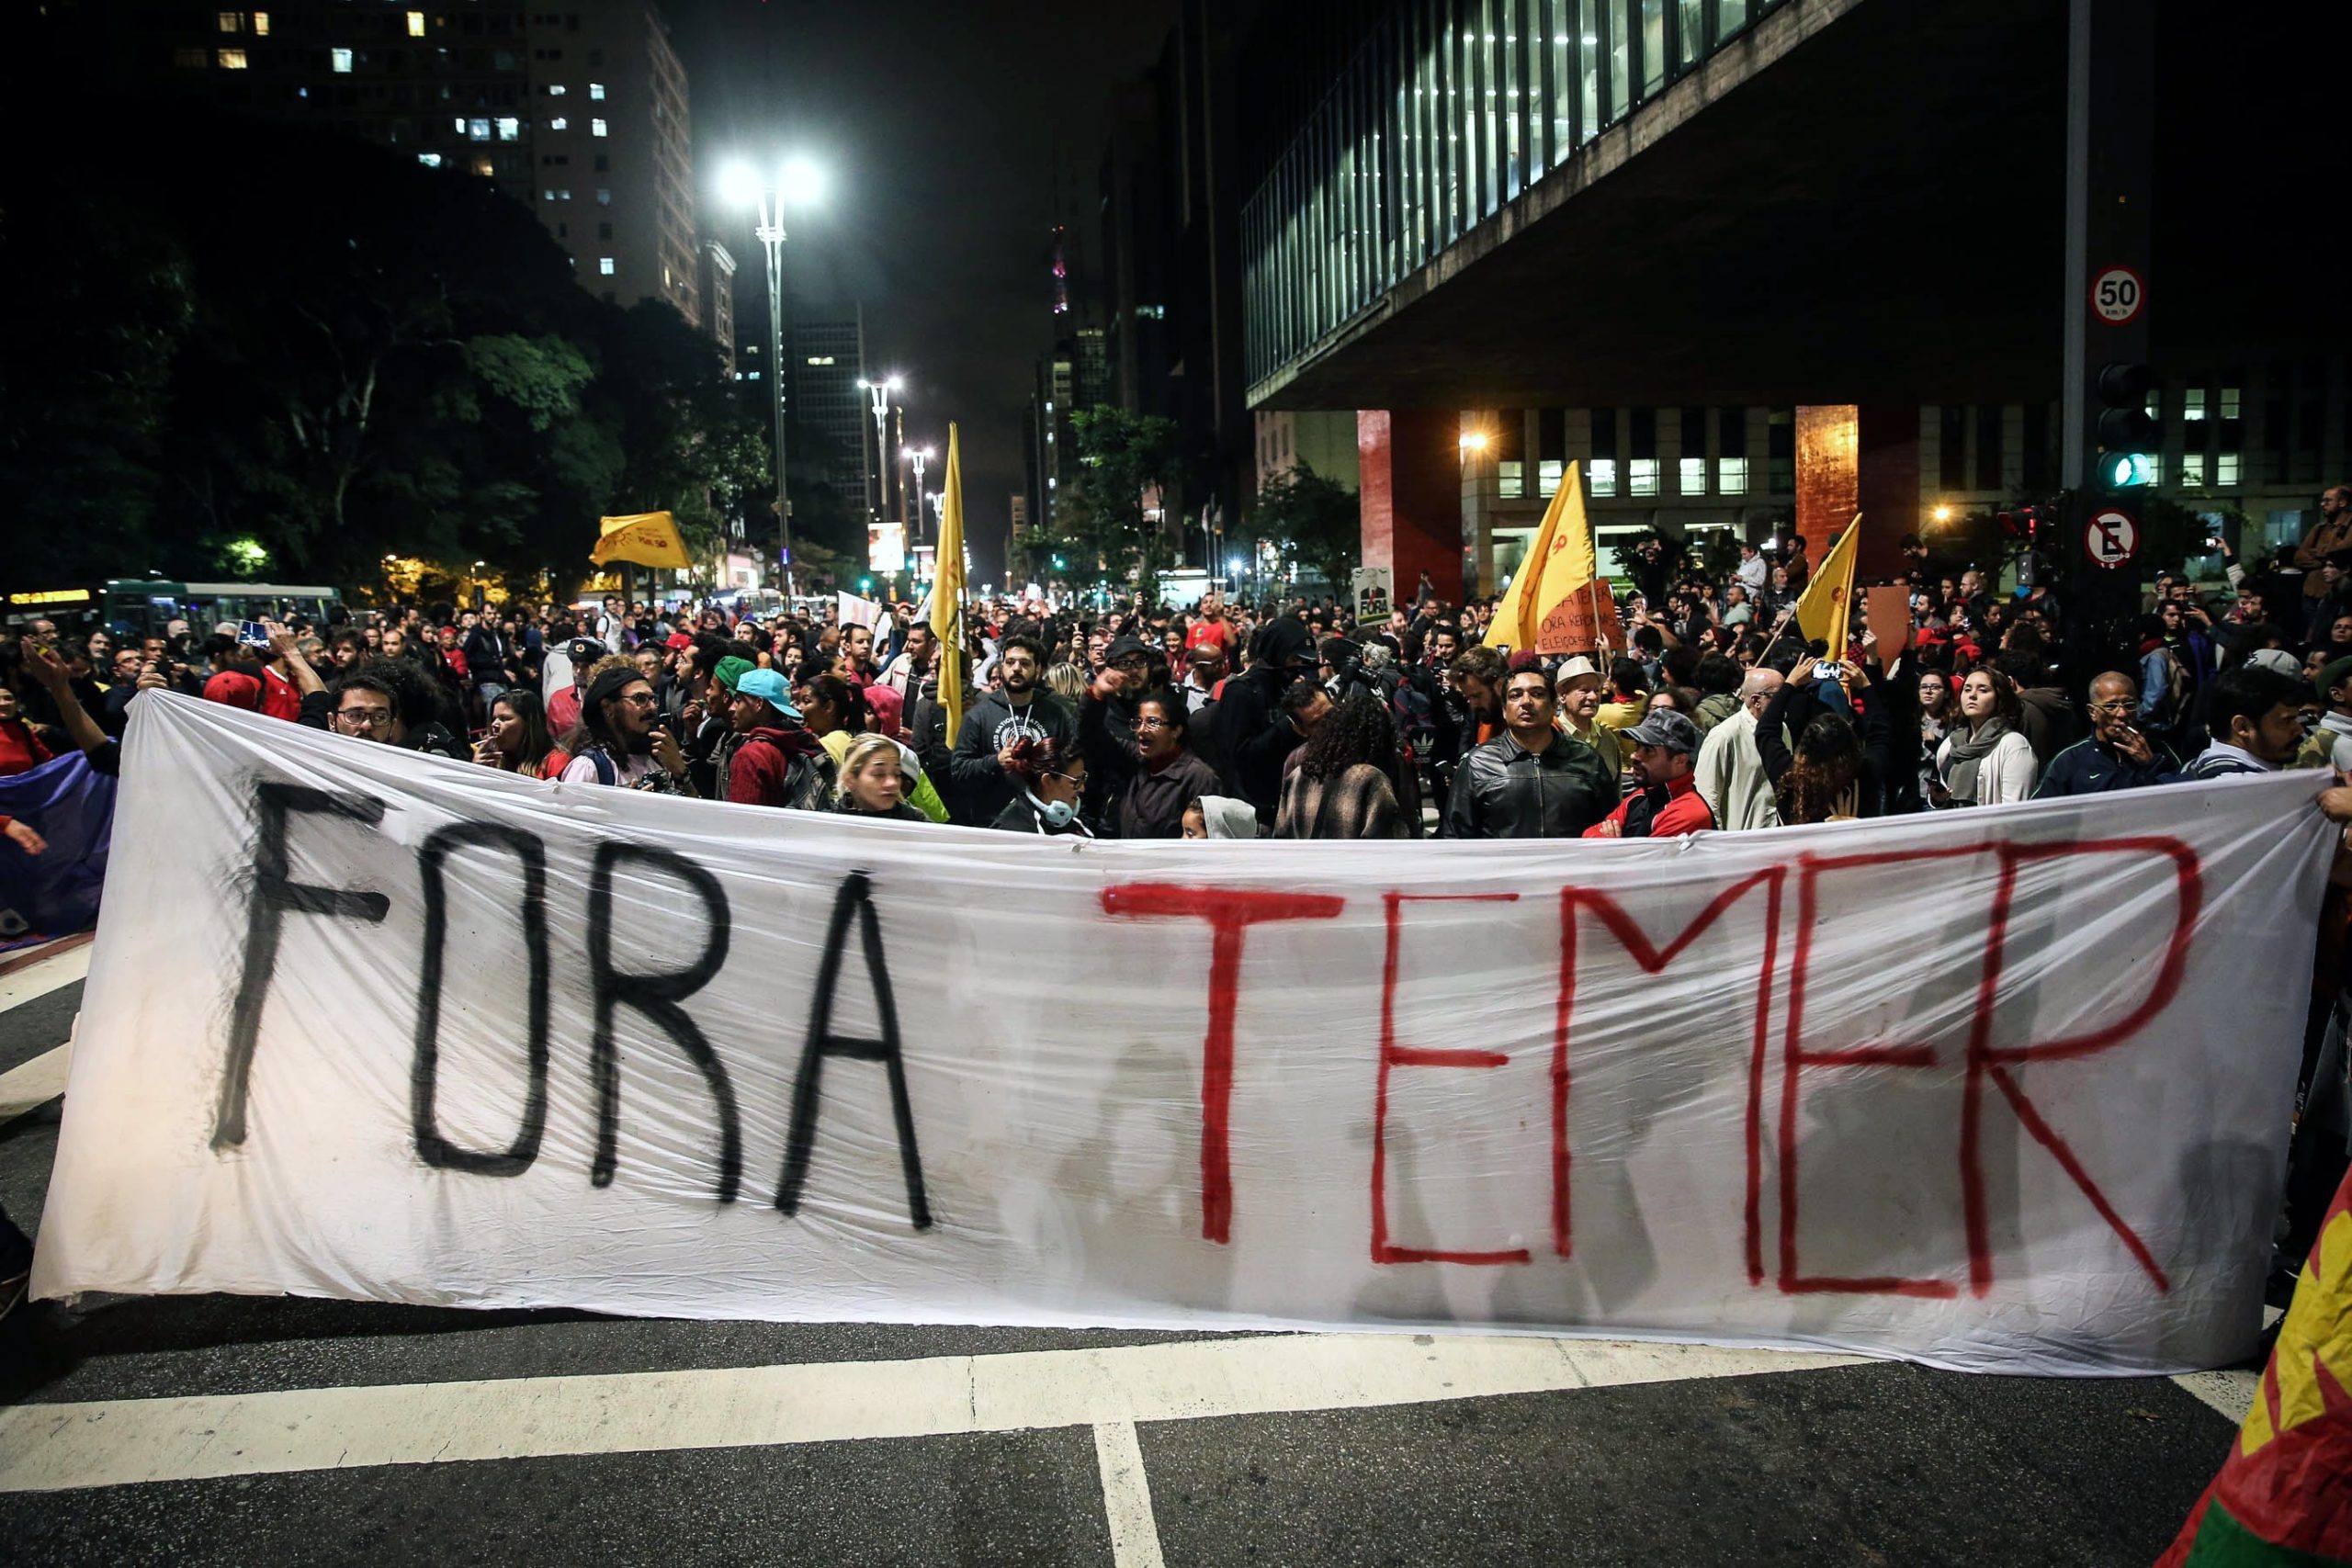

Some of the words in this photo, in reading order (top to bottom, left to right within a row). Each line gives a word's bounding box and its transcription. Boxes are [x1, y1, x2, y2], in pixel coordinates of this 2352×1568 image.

[2100, 279, 2136, 307] 50
[2102, 522, 2121, 556] E
[1360, 599, 1388, 615] FORA
[1542, 615, 1566, 634] ORA
[1030, 719, 1047, 738] ATIONS
[209, 780, 933, 1232] FORA
[1102, 834, 2202, 1299] TEMER
